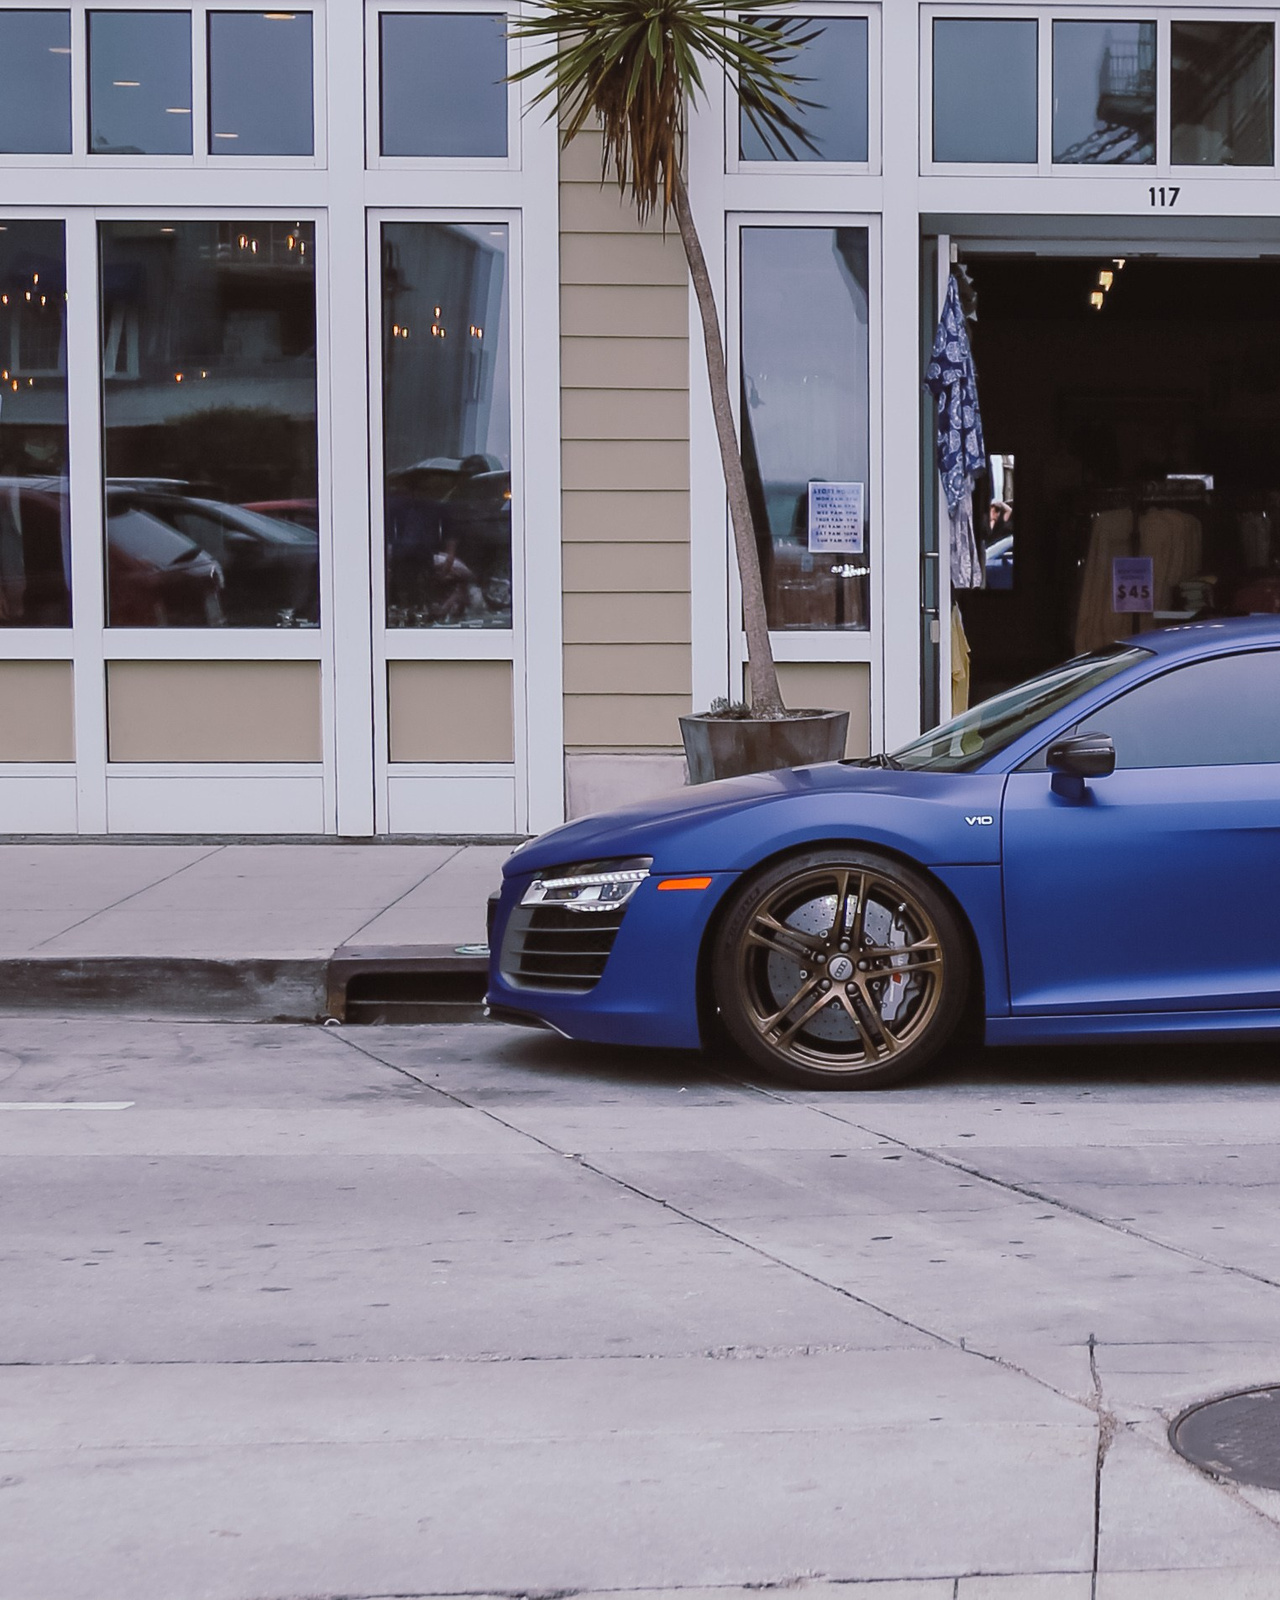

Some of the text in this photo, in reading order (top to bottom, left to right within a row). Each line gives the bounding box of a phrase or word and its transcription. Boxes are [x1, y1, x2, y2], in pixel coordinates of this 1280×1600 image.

[1149, 187, 1180, 206] 117
[1117, 584, 1150, 600] $45
[965, 816, 993, 826] V10
